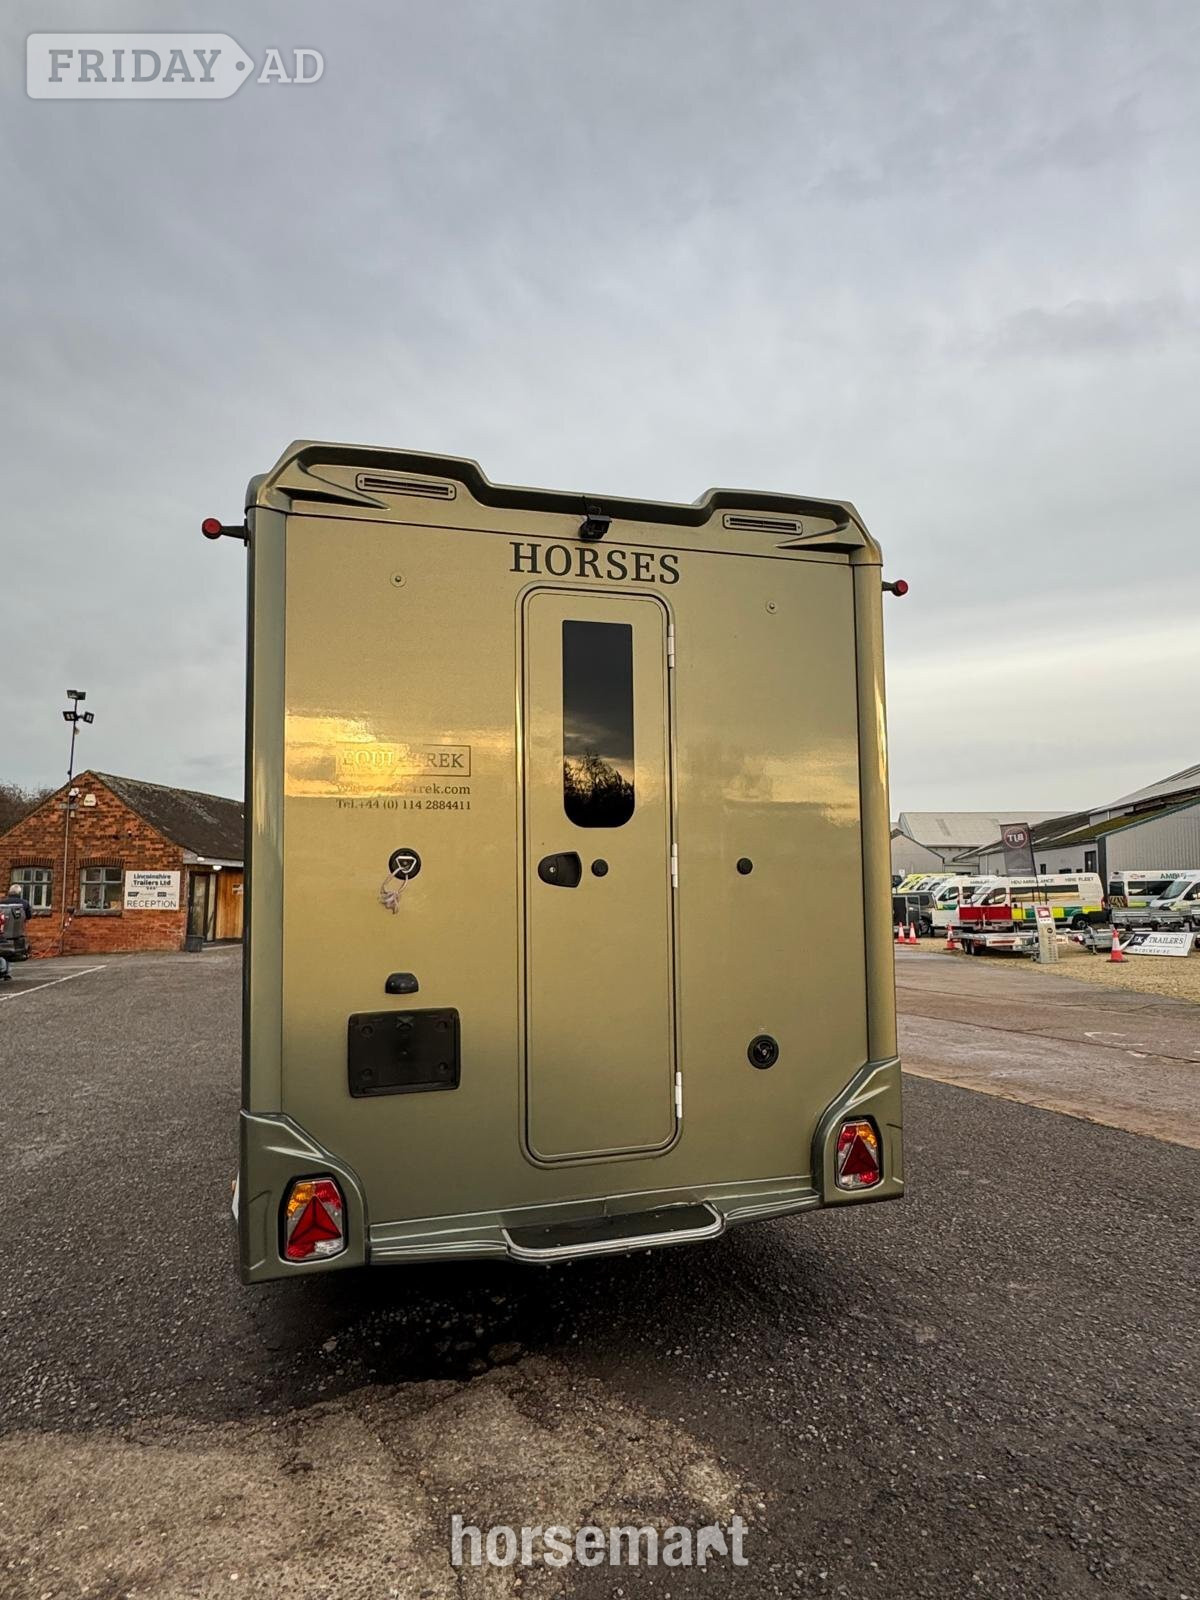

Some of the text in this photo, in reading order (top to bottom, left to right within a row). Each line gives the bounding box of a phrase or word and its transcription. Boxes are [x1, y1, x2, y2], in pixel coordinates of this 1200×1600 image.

[509, 541, 680, 585] HORSES
[403, 800, 422, 810] 114
[426, 800, 471, 810] 2884411
[127, 900, 177, 908] RECEPTION
[1149, 935, 1184, 945] TRAILERS
